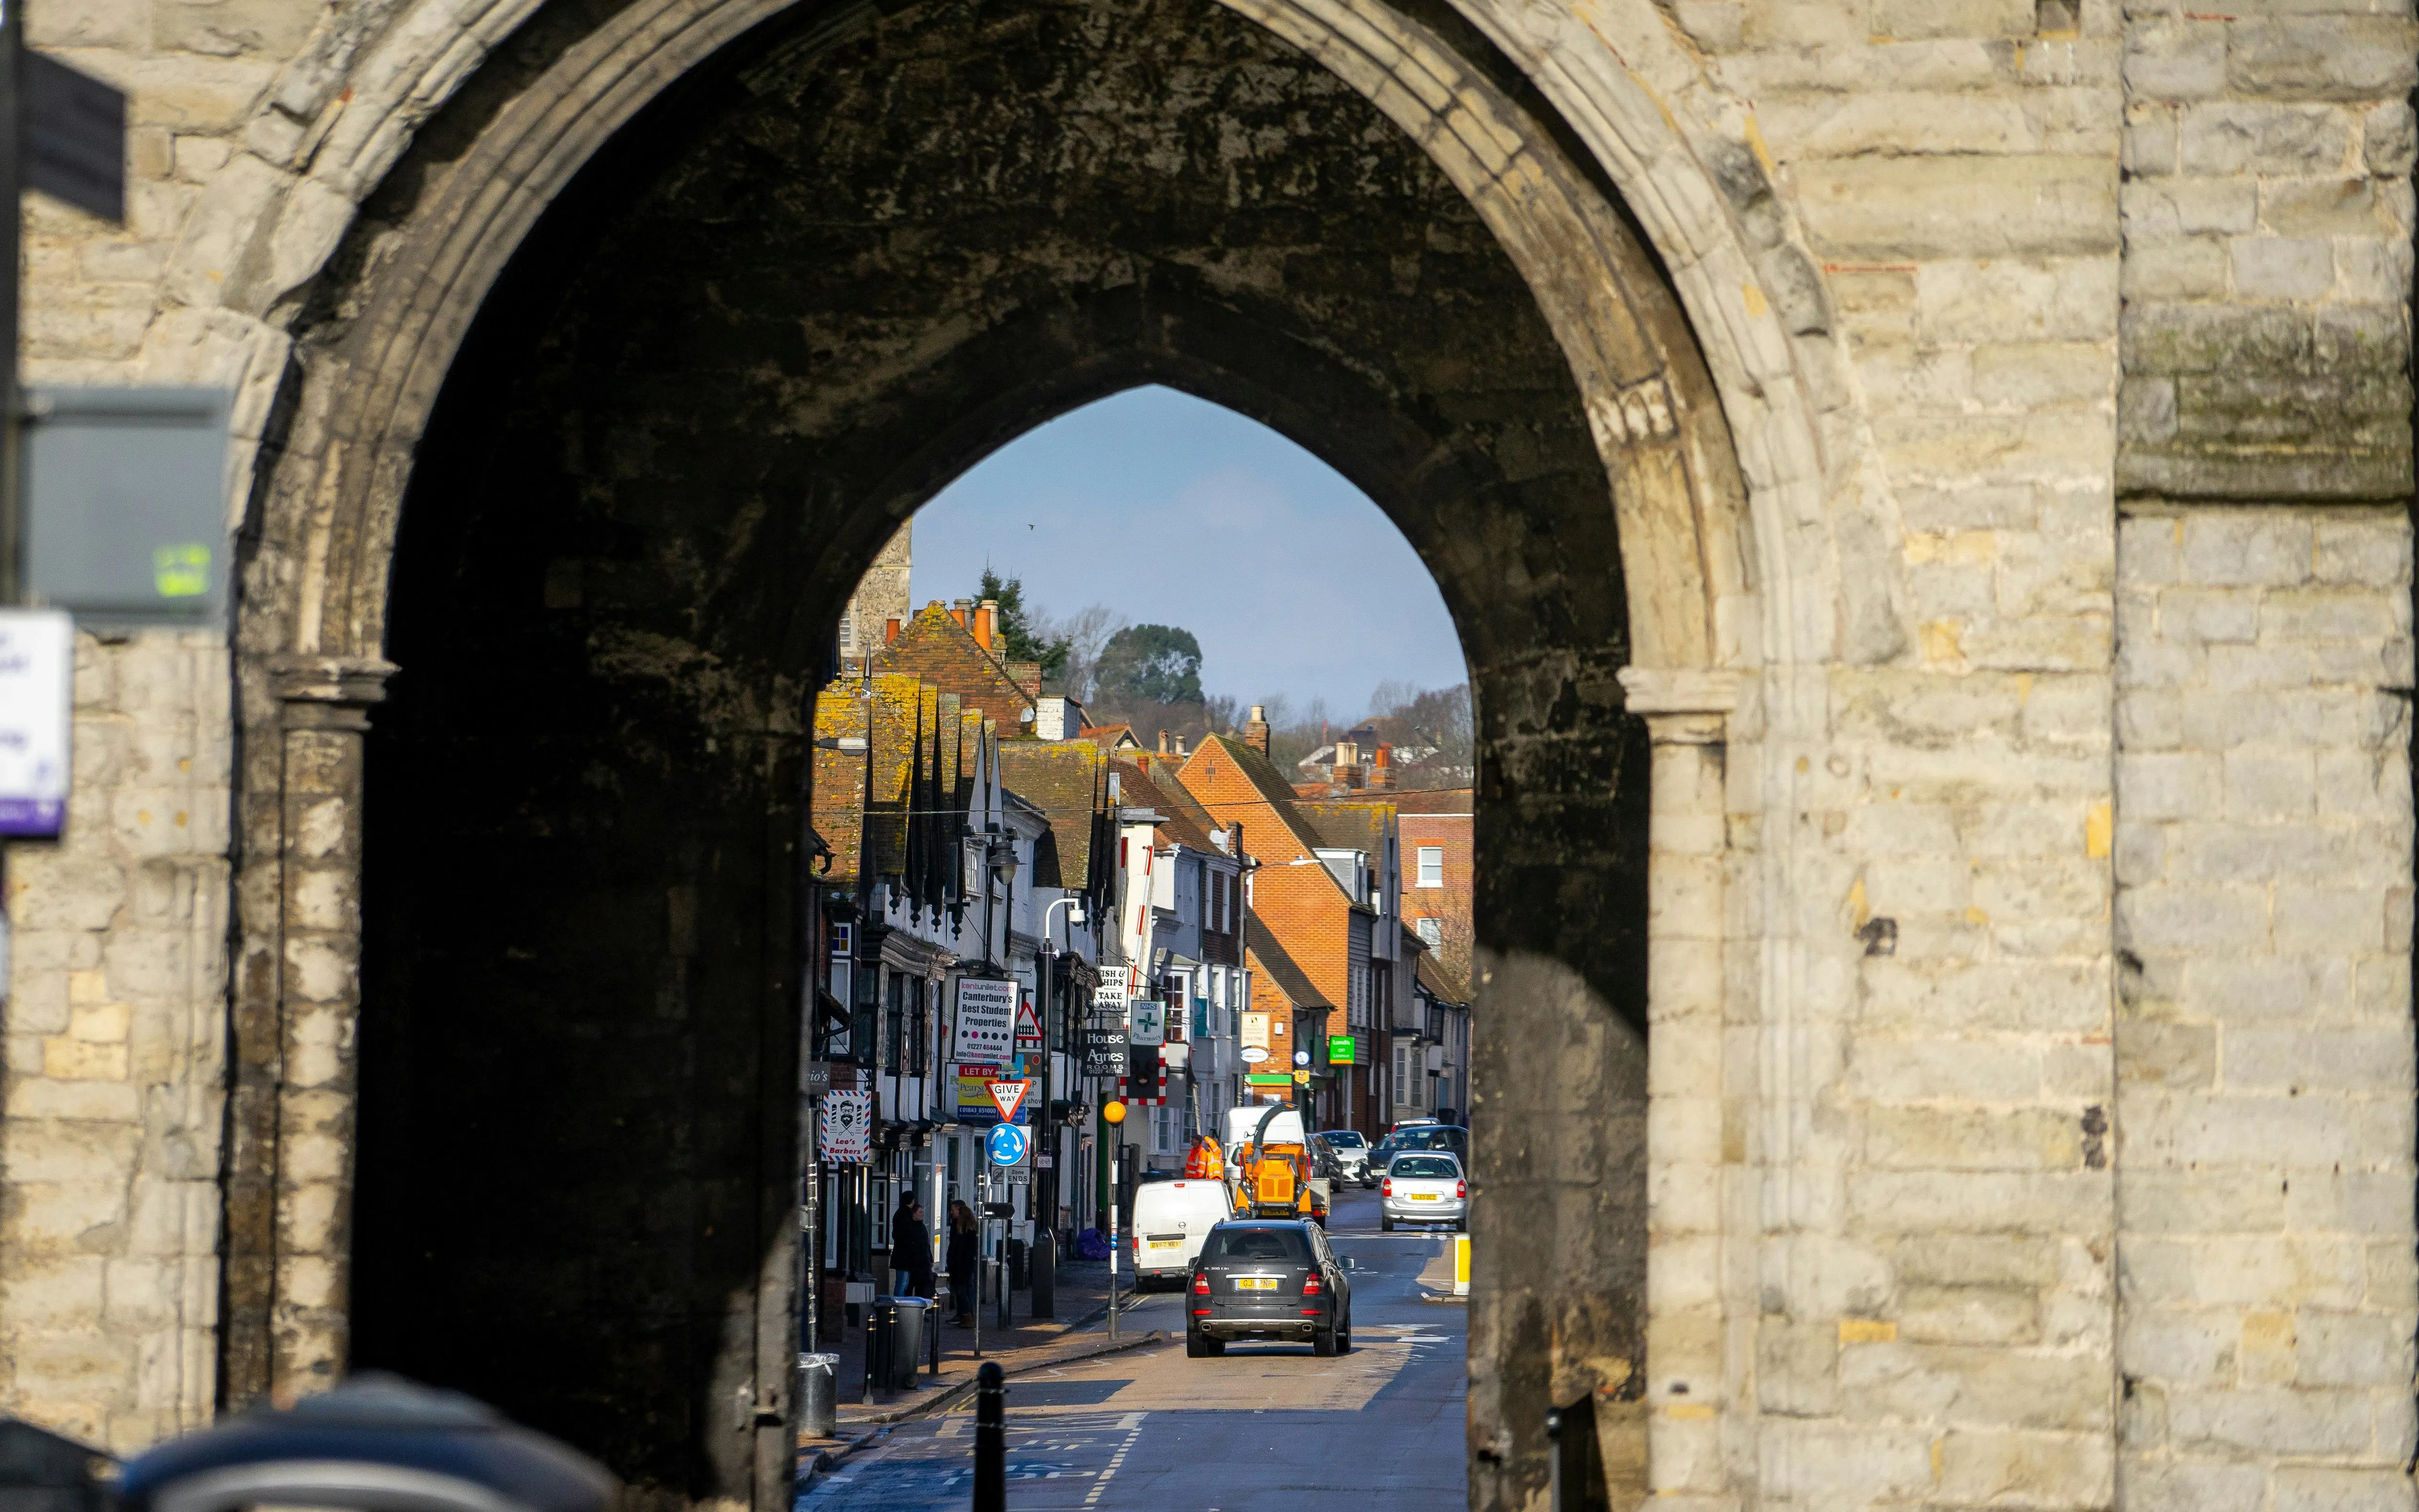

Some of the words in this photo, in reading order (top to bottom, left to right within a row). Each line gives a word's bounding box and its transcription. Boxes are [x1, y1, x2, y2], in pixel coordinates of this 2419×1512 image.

[962, 982, 1014, 992] kentunilet.com
[963, 992, 1012, 1004] Canterbury's
[962, 1004, 980, 1013] Best
[981, 1005, 1011, 1016] Student
[965, 1017, 1007, 1028] Properties
[1087, 1033, 1124, 1043] House
[1133, 1032, 1162, 1041] Pharmacy
[956, 1051, 1011, 1061] info@kentunilet.com
[1087, 1049, 1124, 1064] Agnes
[808, 1071, 828, 1081] io's
[960, 1083, 988, 1092] Pearso
[995, 1085, 1019, 1093] GIVE
